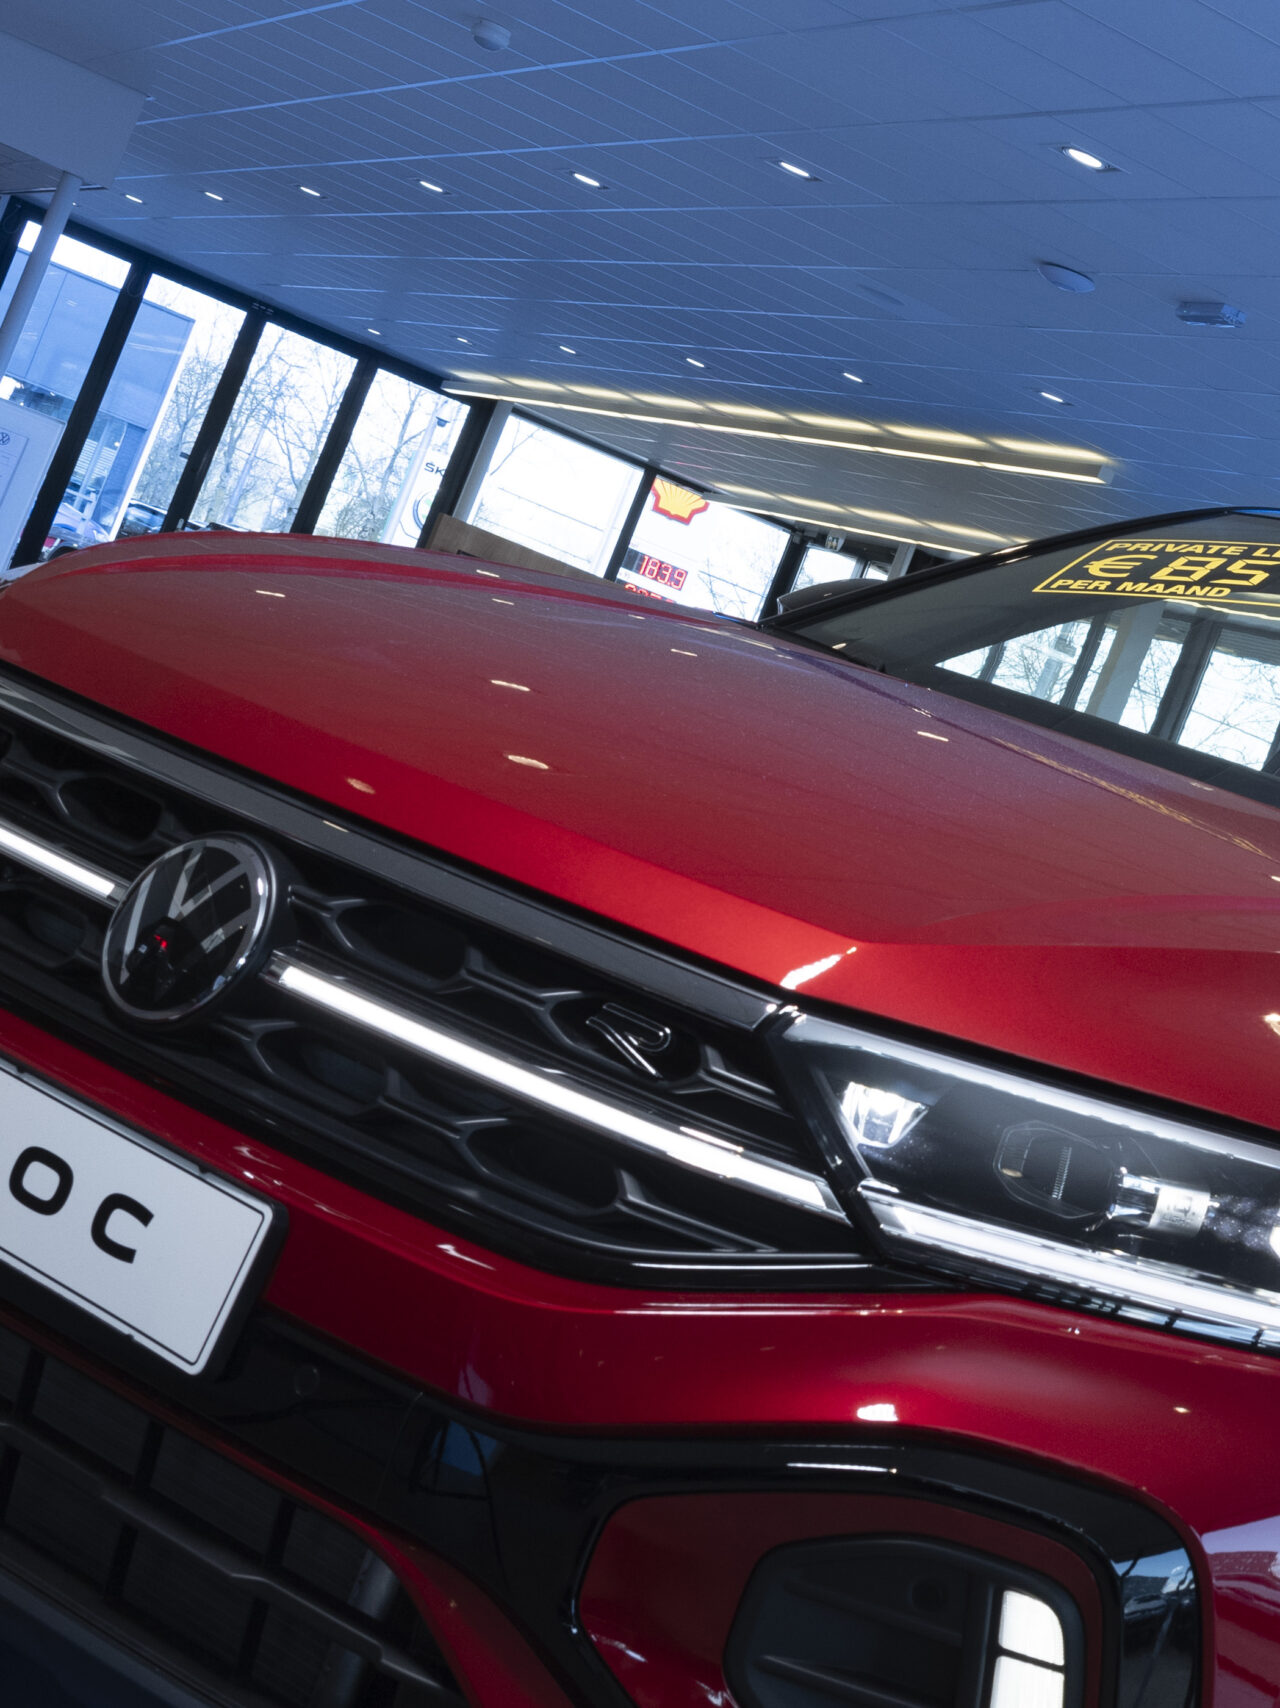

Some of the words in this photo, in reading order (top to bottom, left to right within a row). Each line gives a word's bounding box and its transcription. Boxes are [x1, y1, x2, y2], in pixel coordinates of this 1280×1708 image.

[1104, 542, 1249, 556] PRIVATE
[1050, 579, 1112, 591] PER
[1116, 581, 1232, 598] MAAND
